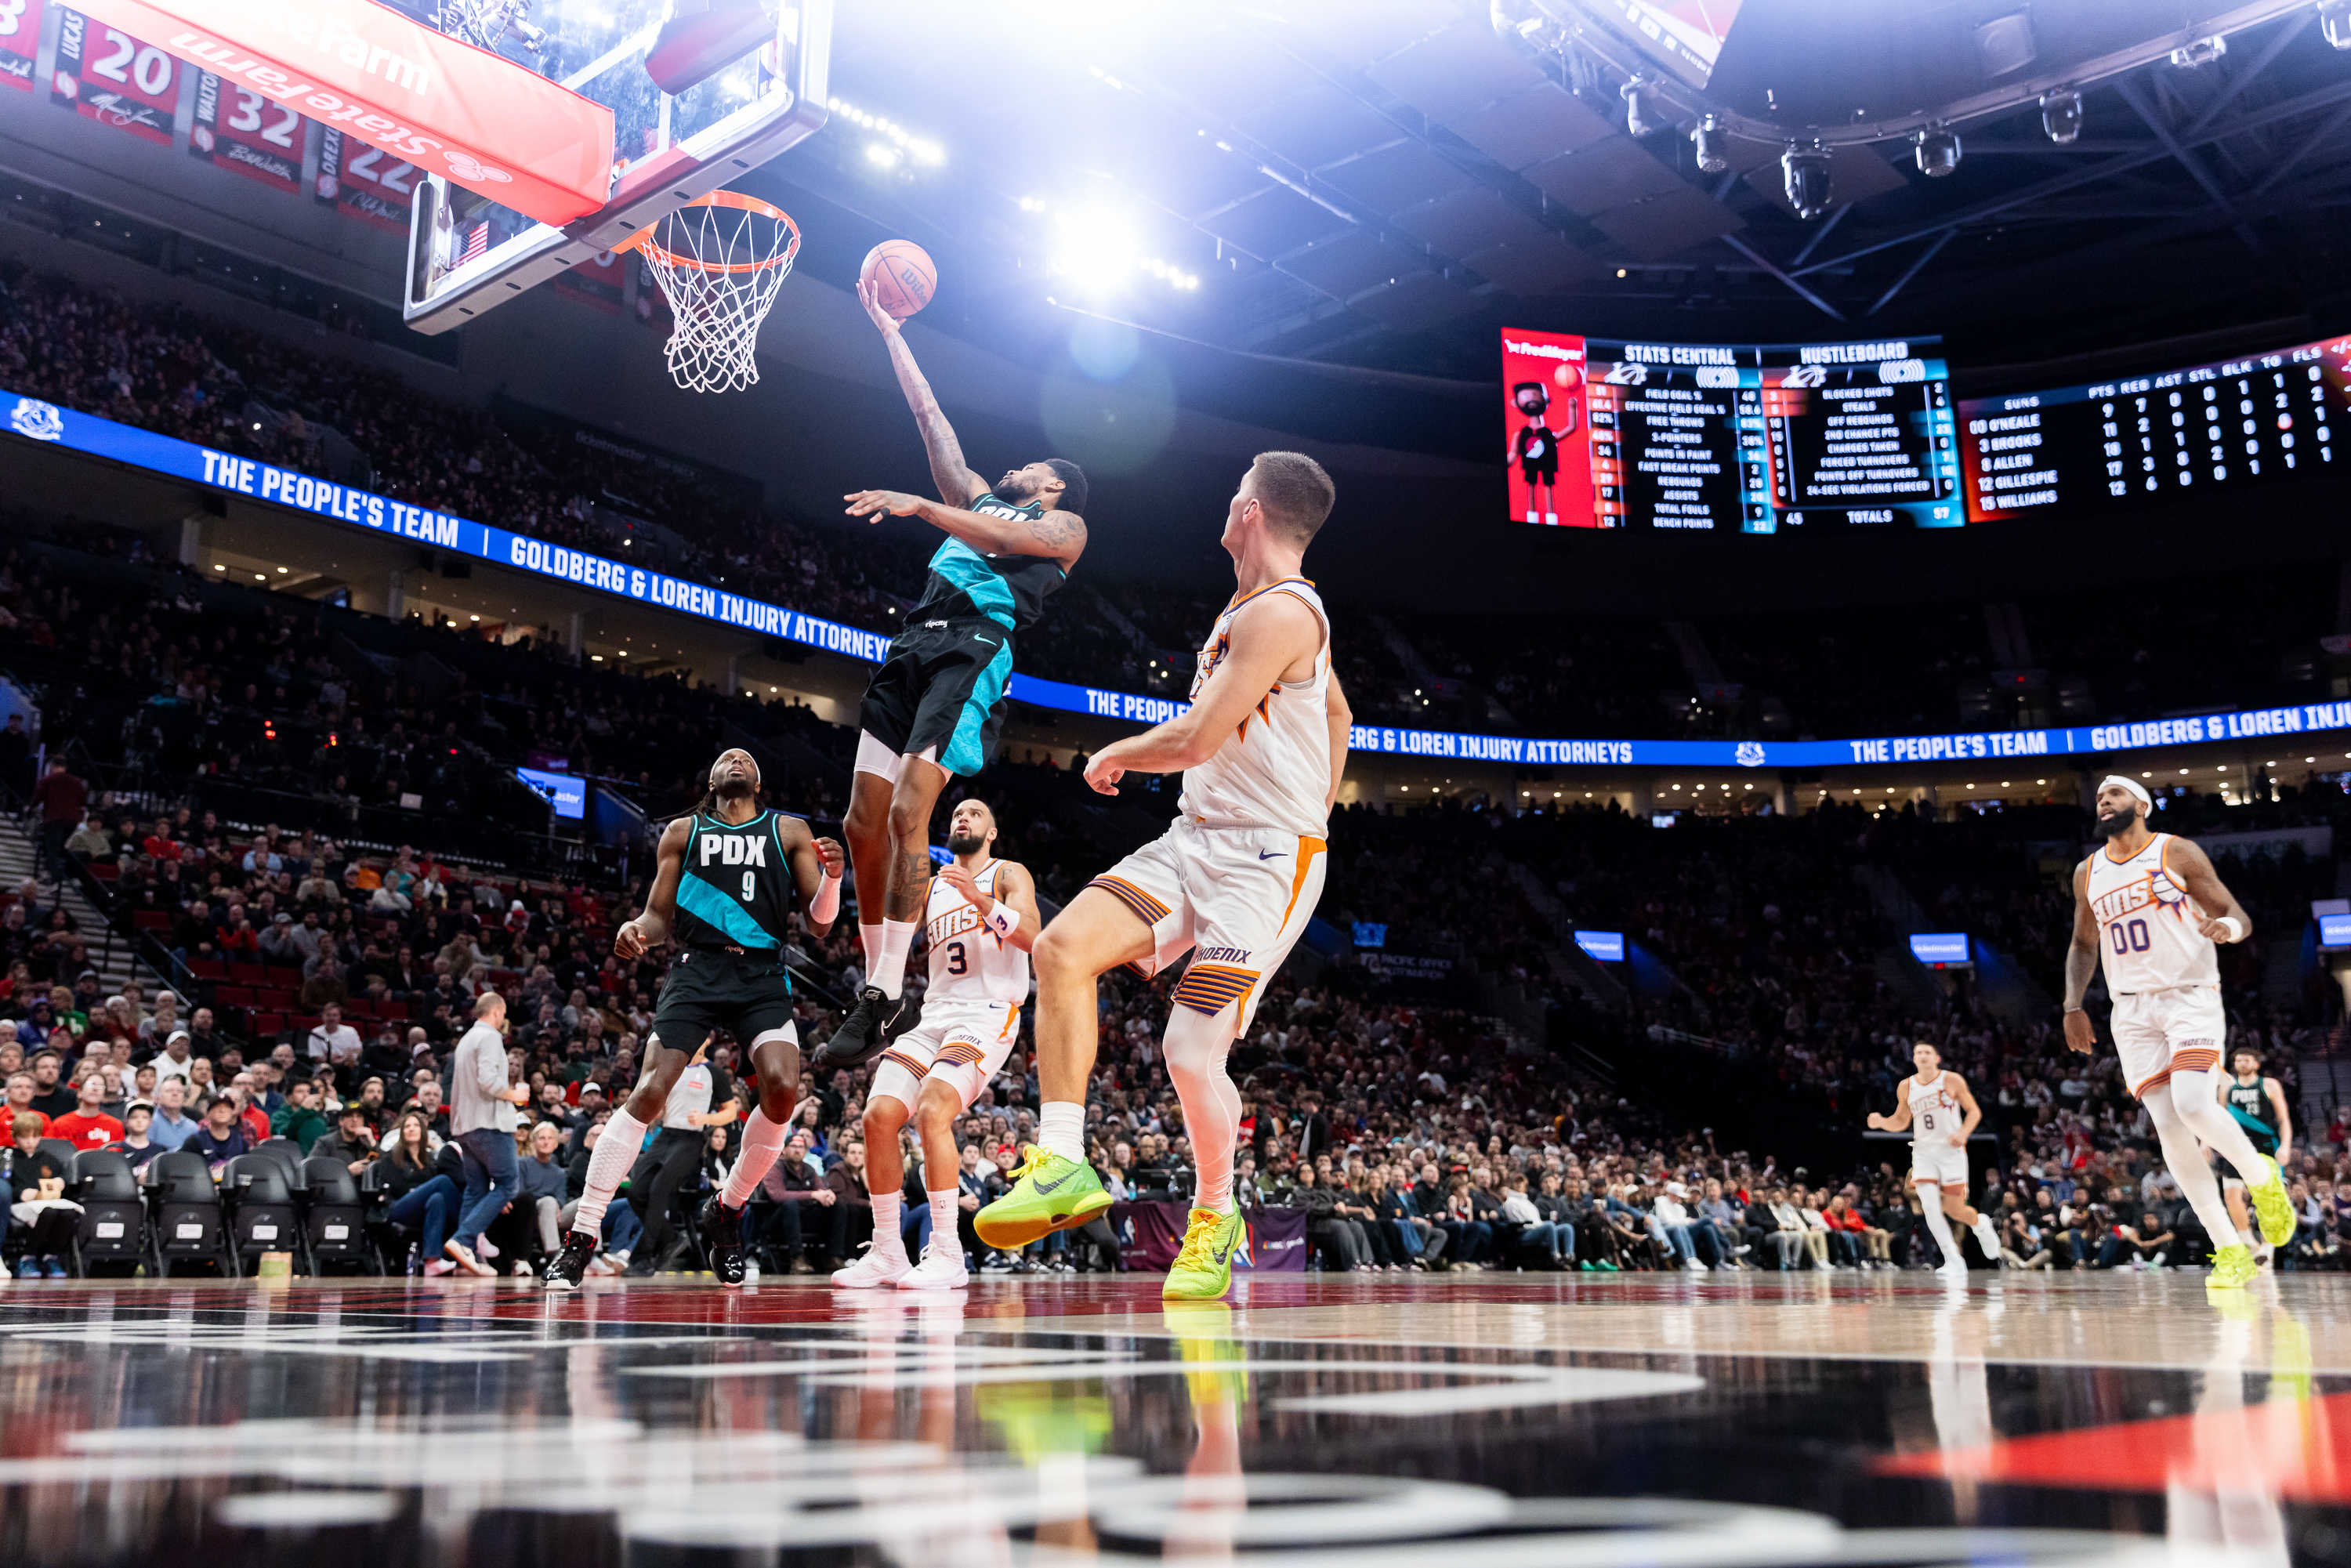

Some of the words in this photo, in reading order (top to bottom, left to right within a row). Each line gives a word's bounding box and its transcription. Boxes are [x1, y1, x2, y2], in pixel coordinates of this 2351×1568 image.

[61, 10, 84, 60] LUCAS
[92, 28, 172, 96] 20
[169, 31, 315, 100] Farm
[317, 13, 429, 96] Farm
[228, 84, 299, 148] 32
[306, 92, 442, 156] State
[1625, 345, 1670, 365] STATS
[1672, 347, 1736, 367] CENTRAL
[1800, 342, 1909, 364] HUSTLEBOARD
[2005, 397, 2039, 410] SUNS
[2089, 385, 2115, 398] PTS
[2121, 379, 2149, 393] REB
[2155, 373, 2181, 388] AST
[2190, 368, 2215, 382] STL
[2222, 360, 2251, 375] BLK
[2261, 355, 2281, 368] TO
[2293, 346, 2322, 362] FLS
[1646, 389, 1671, 399] FIELD
[1668, 390, 1694, 400] GOAL
[1823, 389, 1865, 399] BLOCKED
[1864, 387, 1893, 397] SHOTS
[1969, 420, 1990, 434] 00
[1989, 414, 2039, 431] O'NEALE
[2103, 404, 2113, 417] 9
[2170, 393, 2181, 407] 0
[2204, 387, 2215, 400] 0
[2239, 381, 2248, 394] 1
[2273, 374, 2283, 387] 1
[2309, 366, 2320, 381] 0
[1625, 401, 1669, 412] EFFECTIVE
[1668, 404, 1694, 415] FIELD
[1694, 404, 1718, 414] GOAL
[1843, 401, 1876, 412] STEALS
[1646, 416, 1670, 425] FREE
[1670, 415, 1704, 429] THROWS
[1828, 416, 1845, 426] OFF
[1846, 415, 1893, 425] REBOUNDS
[1980, 439, 1989, 452] 3
[1991, 433, 2041, 451] BROOKS
[2103, 422, 2117, 436] 11
[2138, 418, 2149, 432] 2
[2172, 412, 2183, 426] 0
[2206, 407, 2217, 420] 0
[2241, 400, 2252, 414] 0
[2276, 393, 2286, 407] 2
[2311, 386, 2322, 401] 2
[1652, 430, 1701, 445] 3-POINTERS
[1825, 430, 1843, 440] 2ND
[1845, 429, 1879, 439] CHANCE
[1879, 428, 1899, 437] PTS
[1981, 458, 1991, 472] 8
[1994, 454, 2032, 469] ALLEN
[2104, 442, 2120, 456] 18
[2142, 437, 2150, 451] 1
[2175, 432, 2184, 446] 1
[2209, 426, 2220, 440] 0
[2244, 420, 2255, 434] 0
[2279, 414, 2291, 428] 0
[2315, 407, 2324, 421] 1
[1645, 447, 1676, 458] POINTS
[1674, 447, 1686, 458] IN
[1685, 450, 1711, 459] PAINT
[1828, 443, 1871, 453] CHARGES
[1868, 441, 1899, 451] TAKEN
[1639, 462, 1661, 471] FAST
[1661, 462, 1691, 473] BREAK
[1690, 464, 1720, 473] POINTS
[1821, 457, 1857, 467] FORCED
[1855, 454, 1909, 465] TURNOVERS
[1978, 477, 1996, 491] 12
[1994, 468, 2057, 489] GILLESPIE
[2106, 462, 2121, 476] 17
[2143, 457, 2154, 471] 3
[2177, 451, 2188, 465] 8
[2212, 446, 2222, 460] 2
[2247, 440, 2258, 454] 0
[2282, 433, 2293, 447] 0
[2317, 427, 2329, 441] 0
[1658, 476, 1702, 487] REBOUNDS
[1815, 471, 1848, 481] POINTS
[1847, 470, 1867, 480] OFF
[1866, 468, 1918, 479] TURNOVERS
[1980, 496, 1998, 510] 15
[1994, 488, 2056, 508] WILLIAMS
[2109, 481, 2125, 495] 12
[2146, 476, 2157, 491] 6
[2179, 472, 2190, 485] 0
[2214, 466, 2225, 480] 0
[2250, 460, 2259, 474] 1
[2285, 454, 2294, 468] 1
[2321, 447, 2330, 461] 1
[202, 450, 255, 493] THE
[262, 467, 384, 527] PEOPLE'S
[391, 502, 458, 547] TEAM
[1664, 491, 1698, 500] ASSISTS
[1841, 483, 1894, 494] VIOLATIONS
[1893, 481, 1929, 492] FORCED
[1655, 504, 1683, 513] TOTAL
[1682, 505, 1709, 514] FOULS
[1787, 512, 1802, 524] 45
[1847, 510, 1892, 523] TOTALS
[1933, 507, 1949, 519] 57
[1654, 517, 1682, 527] BENCH
[1683, 519, 1713, 528] POINTS
[510, 537, 625, 593] GOLDBERG
[631, 570, 646, 597] &
[651, 575, 715, 617] LOREN
[720, 593, 791, 637] INJURY
[1086, 690, 1119, 716] THE
[2092, 719, 2203, 750] GOLDBERG
[2208, 716, 2224, 739] &
[2229, 708, 2301, 737] LOREN
[1383, 730, 1396, 751] &
[1400, 731, 1455, 755] LOREN
[1459, 736, 1522, 761] INJURY
[1527, 741, 1632, 762] ATTORNEYS
[1850, 741, 1889, 762] THE
[1893, 735, 1986, 760] PEOPLE'S
[1990, 732, 2047, 755] TEAM
[701, 835, 767, 867] PDX
[742, 871, 755, 901] 9
[996, 914, 1009, 932] 3
[2110, 918, 2150, 955] 00
[725, 945, 744, 954] ripcity
[947, 941, 968, 975] 3
[1924, 1114, 1934, 1129] 8
